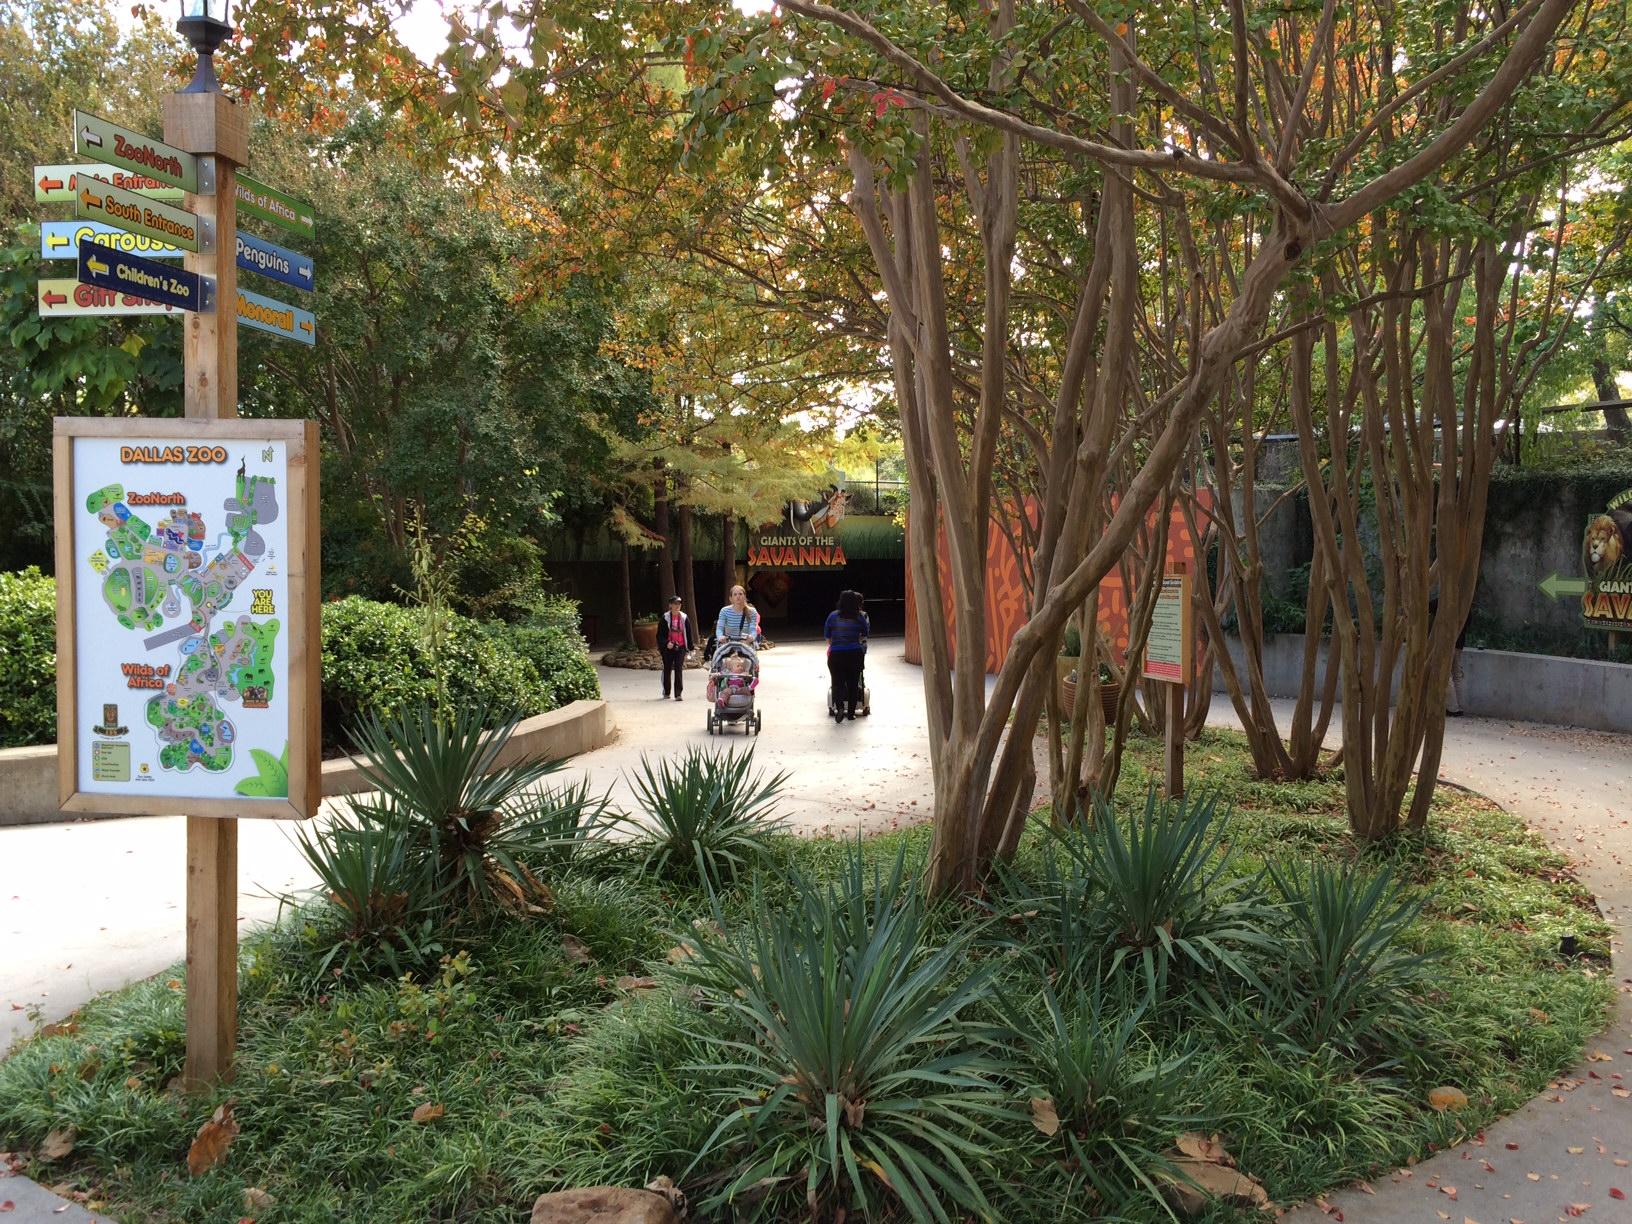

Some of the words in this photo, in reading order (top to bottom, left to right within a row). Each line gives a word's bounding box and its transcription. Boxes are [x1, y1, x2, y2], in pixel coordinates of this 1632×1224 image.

[113, 134, 183, 178] ZooNorth
[257, 194, 268, 209] of
[269, 199, 296, 222] Africa
[105, 195, 142, 223] South
[144, 208, 194, 240] Entrance
[236, 237, 290, 275] Penguins
[116, 263, 168, 292] Children's
[170, 278, 190, 297] Zoo
[120, 446, 184, 464] DALLAS
[187, 446, 228, 464] ZOO
[127, 492, 186, 506] ZooNorth
[760, 535, 797, 546] GIANTS
[798, 535, 813, 546] OF
[814, 535, 834, 546] THE
[747, 546, 848, 567] SAVANNA
[252, 588, 274, 598] YOU
[253, 597, 273, 606] ARE
[251, 604, 275, 615] HERE
[1583, 591, 1632, 620] SAV
[121, 663, 155, 677] Wilds
[155, 664, 171, 677] of
[128, 675, 164, 689] Africa
